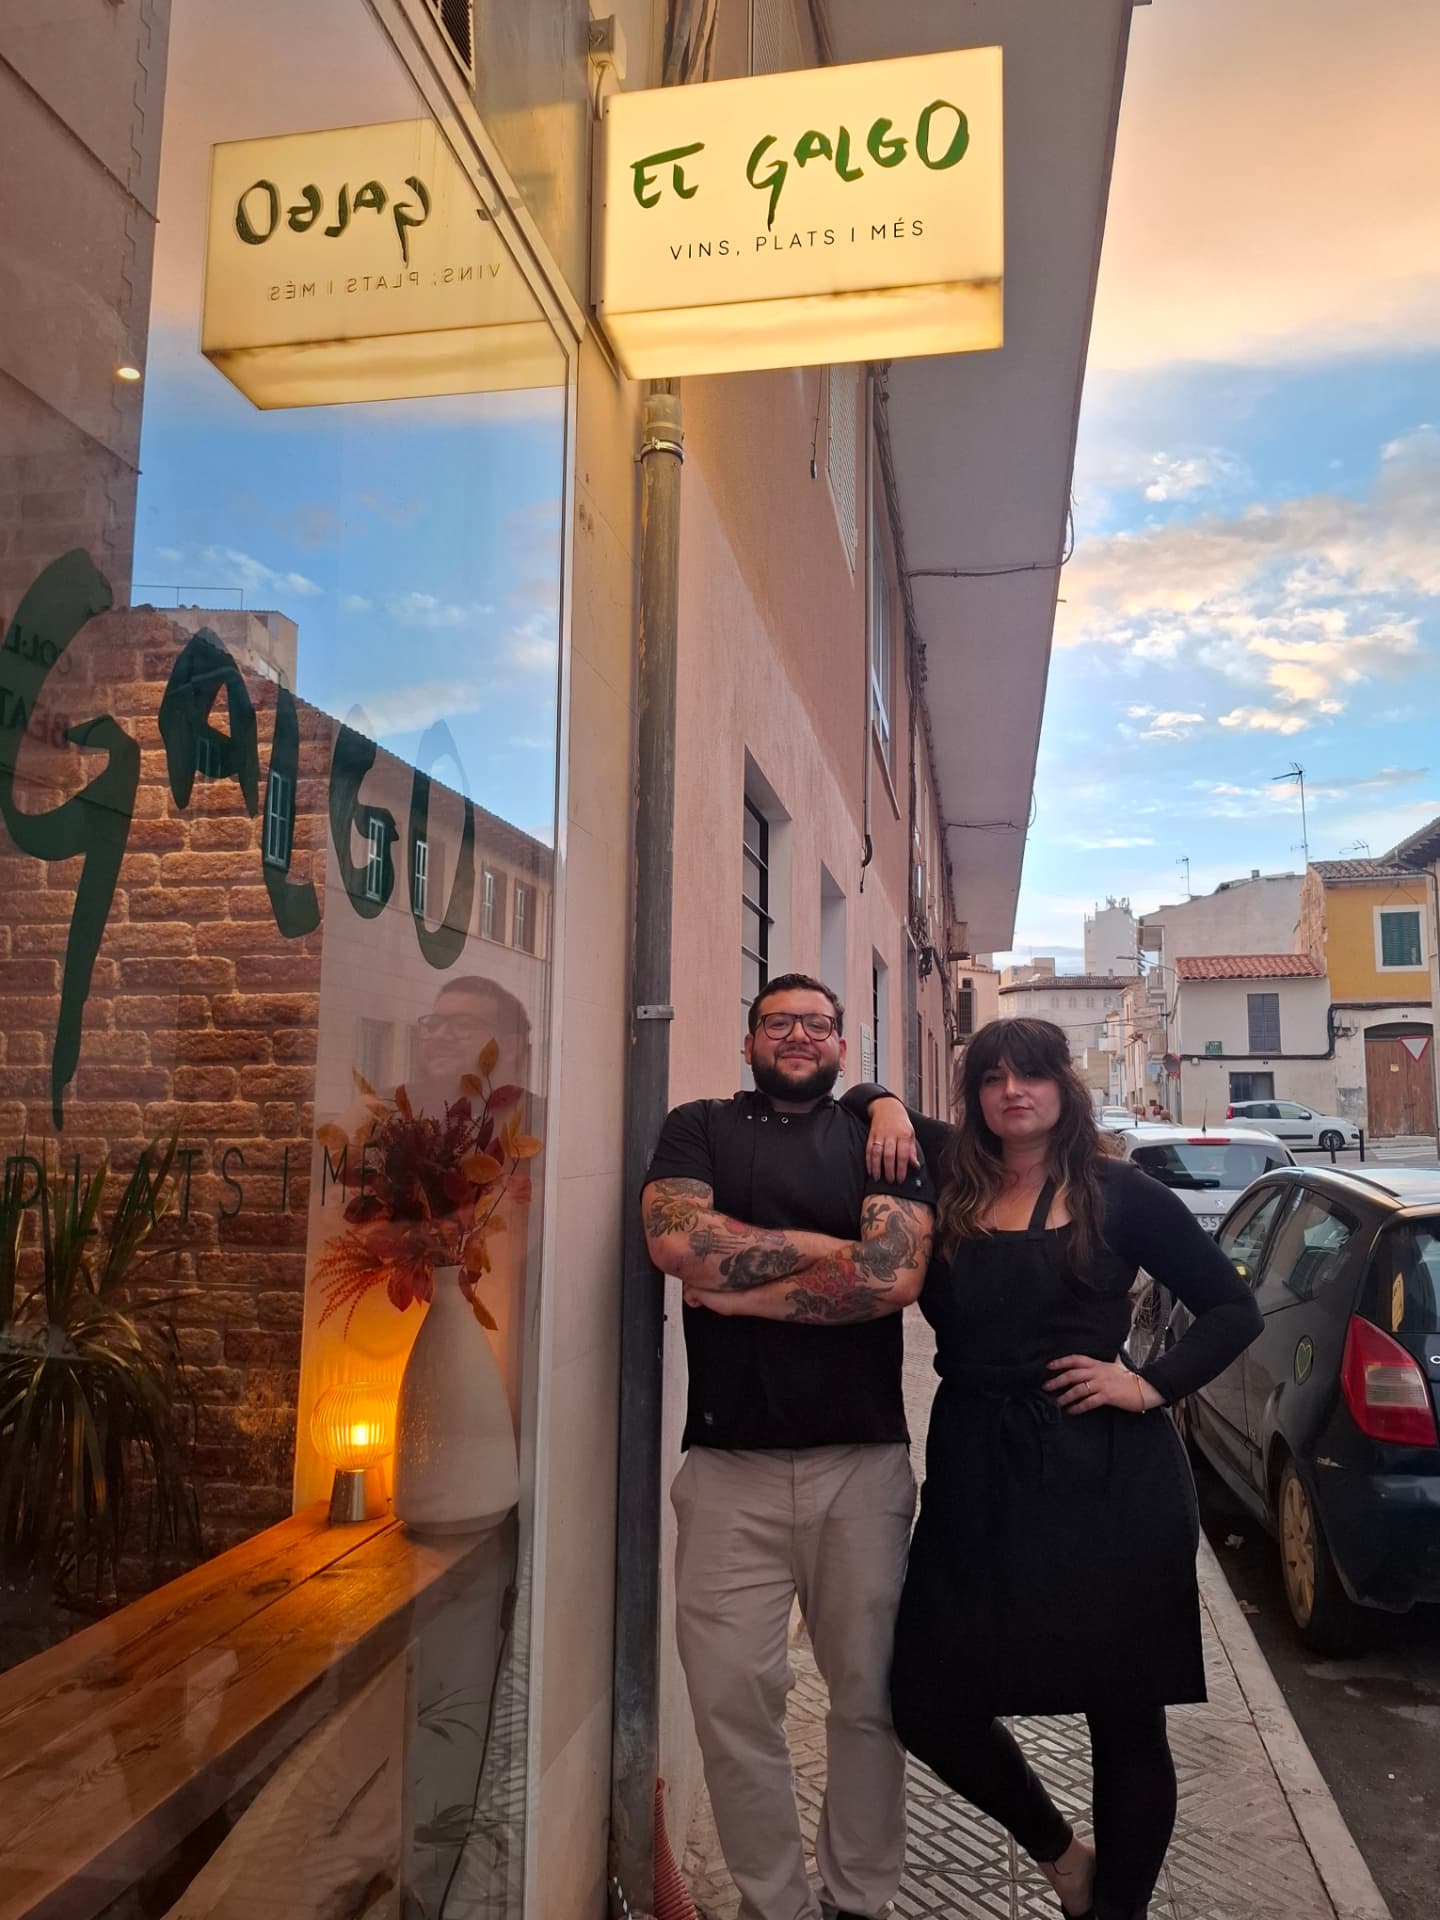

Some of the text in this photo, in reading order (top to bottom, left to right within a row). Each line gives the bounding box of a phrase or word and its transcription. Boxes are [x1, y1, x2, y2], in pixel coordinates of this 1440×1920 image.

[629, 141, 705, 209] EL
[745, 99, 970, 232] GALGO
[669, 217, 925, 261] VINS, PLATS I MÉS
[0, 547, 476, 1132] GALGO
[4, 1145, 245, 1236] PLATS
